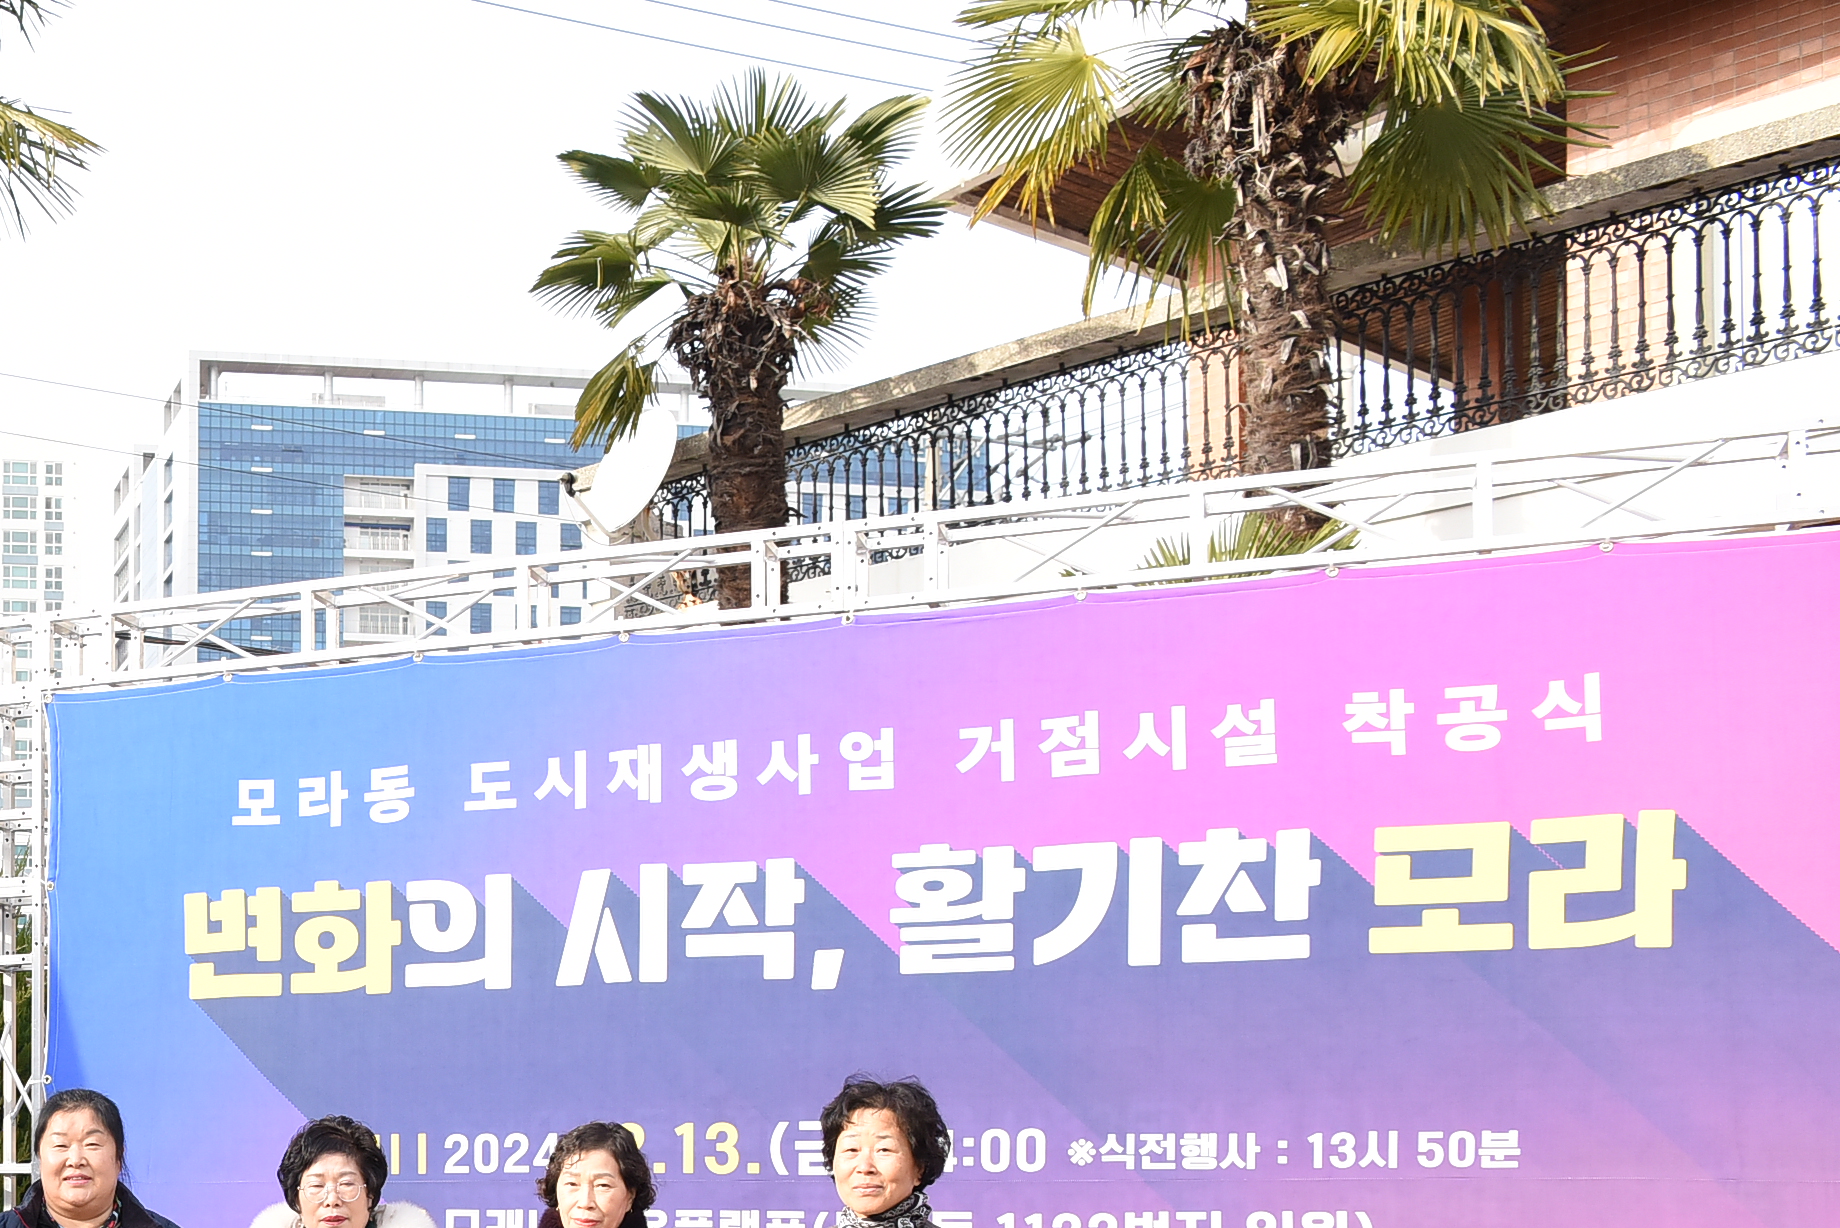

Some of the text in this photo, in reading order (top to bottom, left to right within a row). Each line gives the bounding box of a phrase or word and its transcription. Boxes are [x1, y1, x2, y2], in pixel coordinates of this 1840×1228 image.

[231, 671, 1603, 828] 모라동 도시재생사업 거점시설 착공식
[183, 808, 1687, 1000] 변화의 시작, 활기찬 모라
[1307, 1130, 1399, 1169] 13시
[1416, 1129, 1521, 1169] 50분
